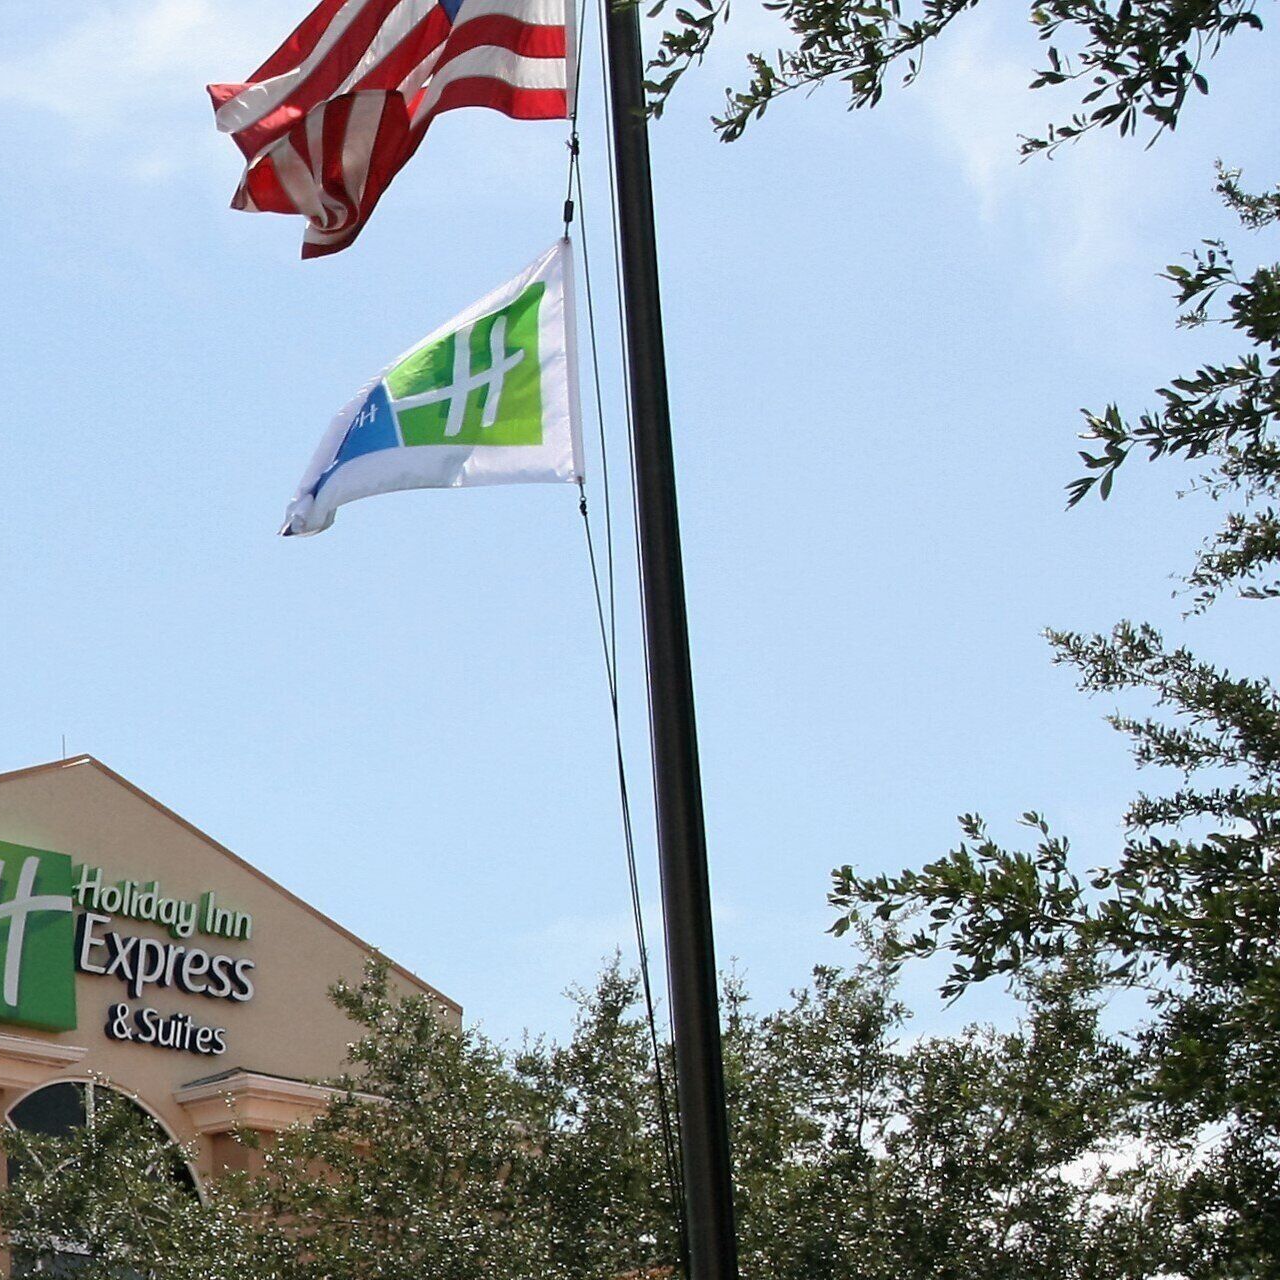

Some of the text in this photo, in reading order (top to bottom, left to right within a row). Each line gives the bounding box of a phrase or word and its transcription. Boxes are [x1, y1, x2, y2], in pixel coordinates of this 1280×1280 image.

[75, 863, 253, 940] Holiday Inn
[79, 912, 256, 1001] Express
[111, 1003, 227, 1055] & Suites
